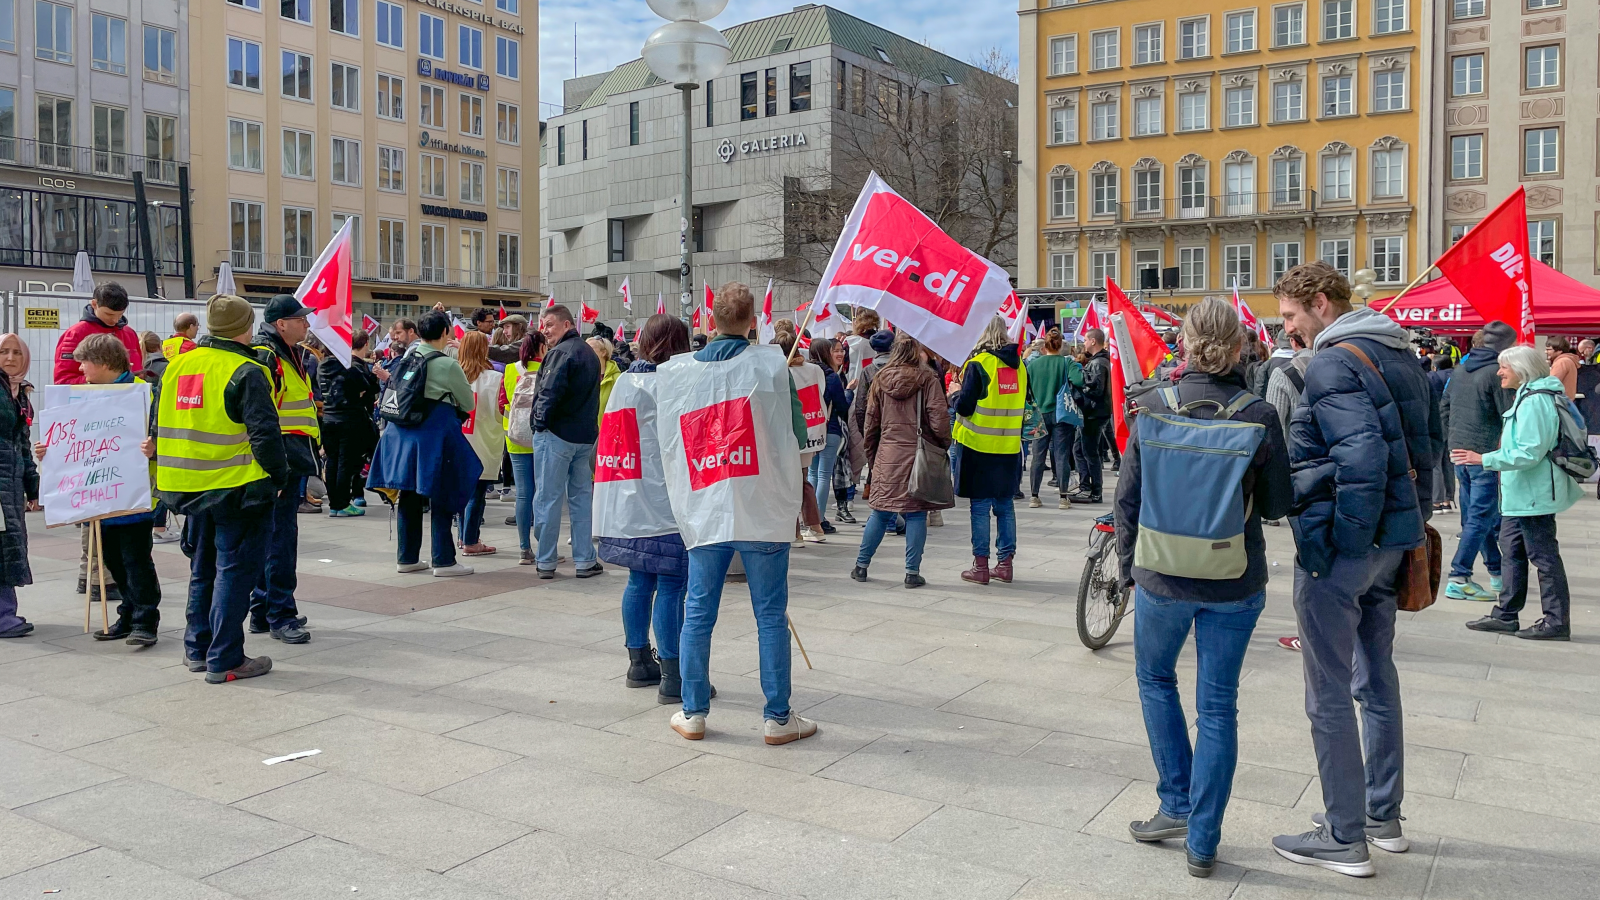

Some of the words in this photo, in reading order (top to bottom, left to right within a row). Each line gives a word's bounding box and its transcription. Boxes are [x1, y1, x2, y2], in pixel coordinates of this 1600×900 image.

[501, 20, 526, 35] BAR
[740, 132, 806, 154] GALERIA
[38, 176, 76, 190] IQOS
[1490, 241, 1524, 279] DIE
[852, 243, 971, 303] ver.di
[1394, 303, 1462, 321] ver.di
[84, 417, 126, 432] WENIGER
[597, 452, 635, 469] ver.di
[692, 446, 751, 471] ver.di
[85, 466, 122, 486] MEHR
[71, 483, 124, 508] GEHALT
